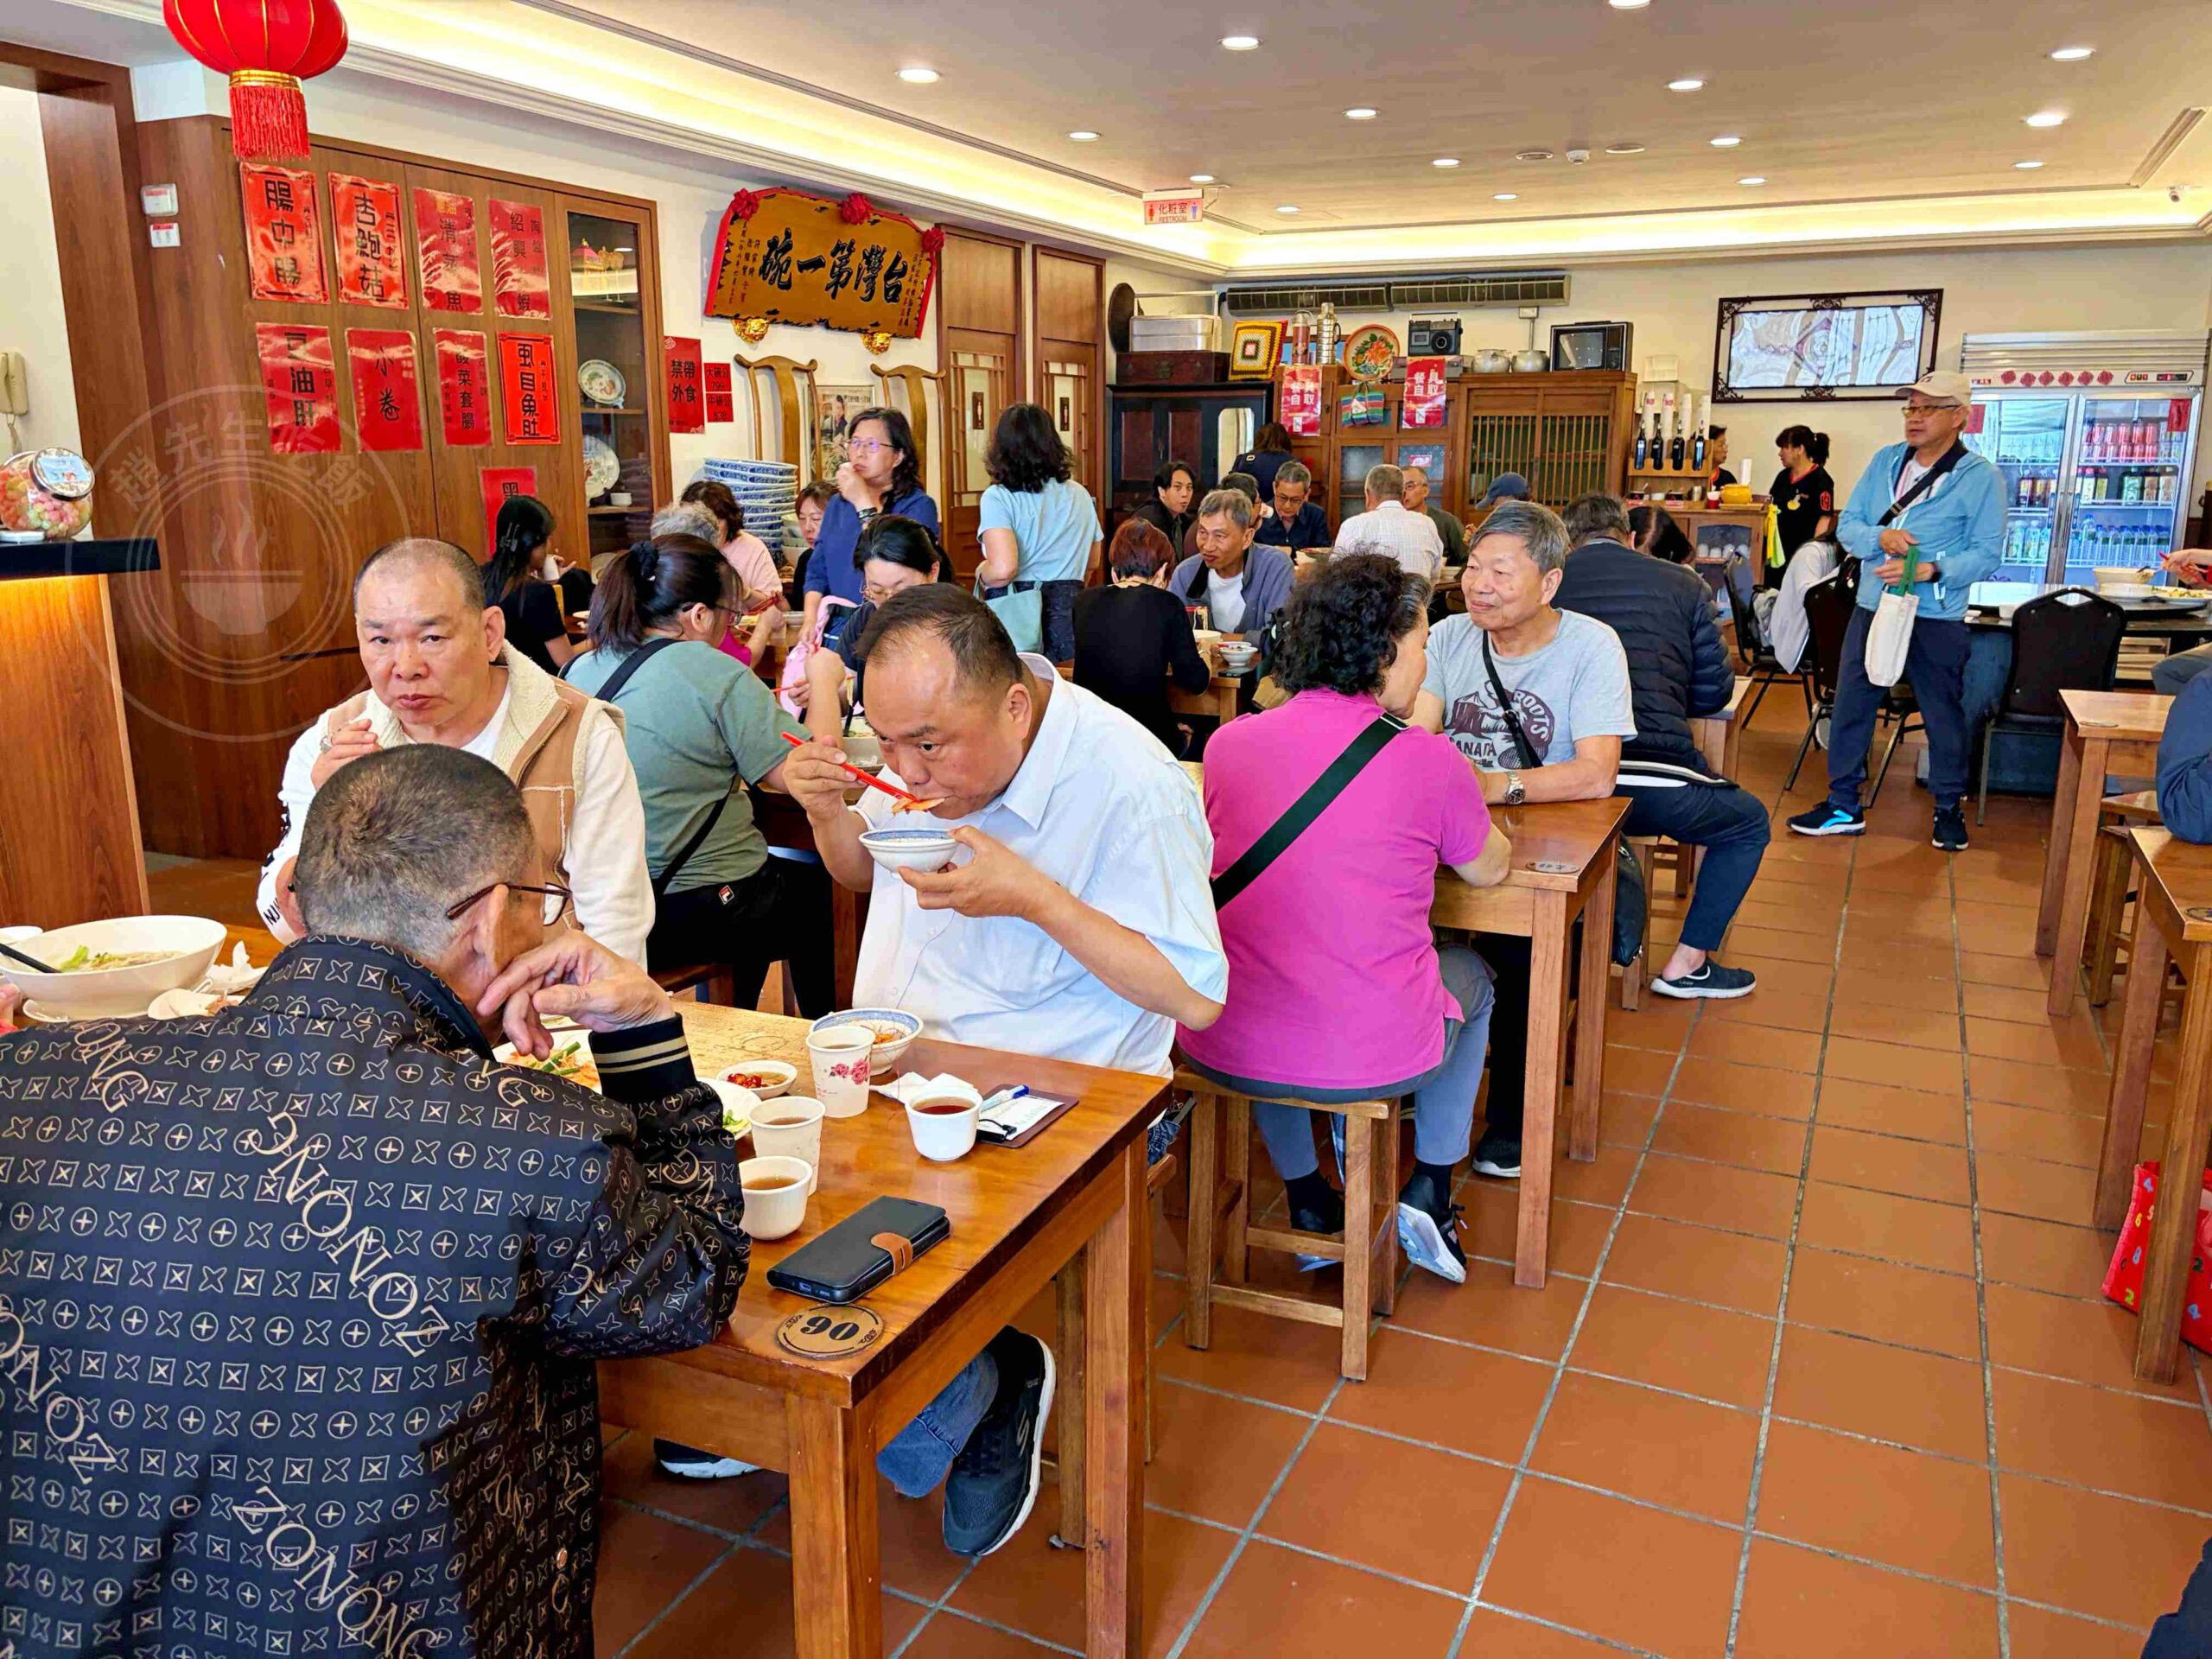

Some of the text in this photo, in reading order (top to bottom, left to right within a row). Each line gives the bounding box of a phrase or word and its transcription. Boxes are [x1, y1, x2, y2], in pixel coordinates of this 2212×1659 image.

[264, 180, 302, 285] 腸中腸
[1159, 202, 1188, 215] 化粧室
[439, 219, 463, 311] 清蒸魚
[511, 209, 531, 308] 紹興蝦
[758, 226, 908, 304] 台灣第一碗
[284, 332, 316, 427] 豆油肝
[374, 346, 400, 421] 小卷
[517, 343, 540, 436] 虱目魚肚
[671, 359, 696, 378] 禁帶
[671, 383, 696, 403] 外食
[1414, 384, 1440, 397] 自取
[1290, 394, 1316, 406] 自取
[1513, 691, 1550, 740] ROOTS
[247, 1111, 450, 1357] ZONONG
[2192, 1257, 2203, 1273] 2
[2125, 1287, 2135, 1306] 2
[800, 1316, 860, 1341] 90
